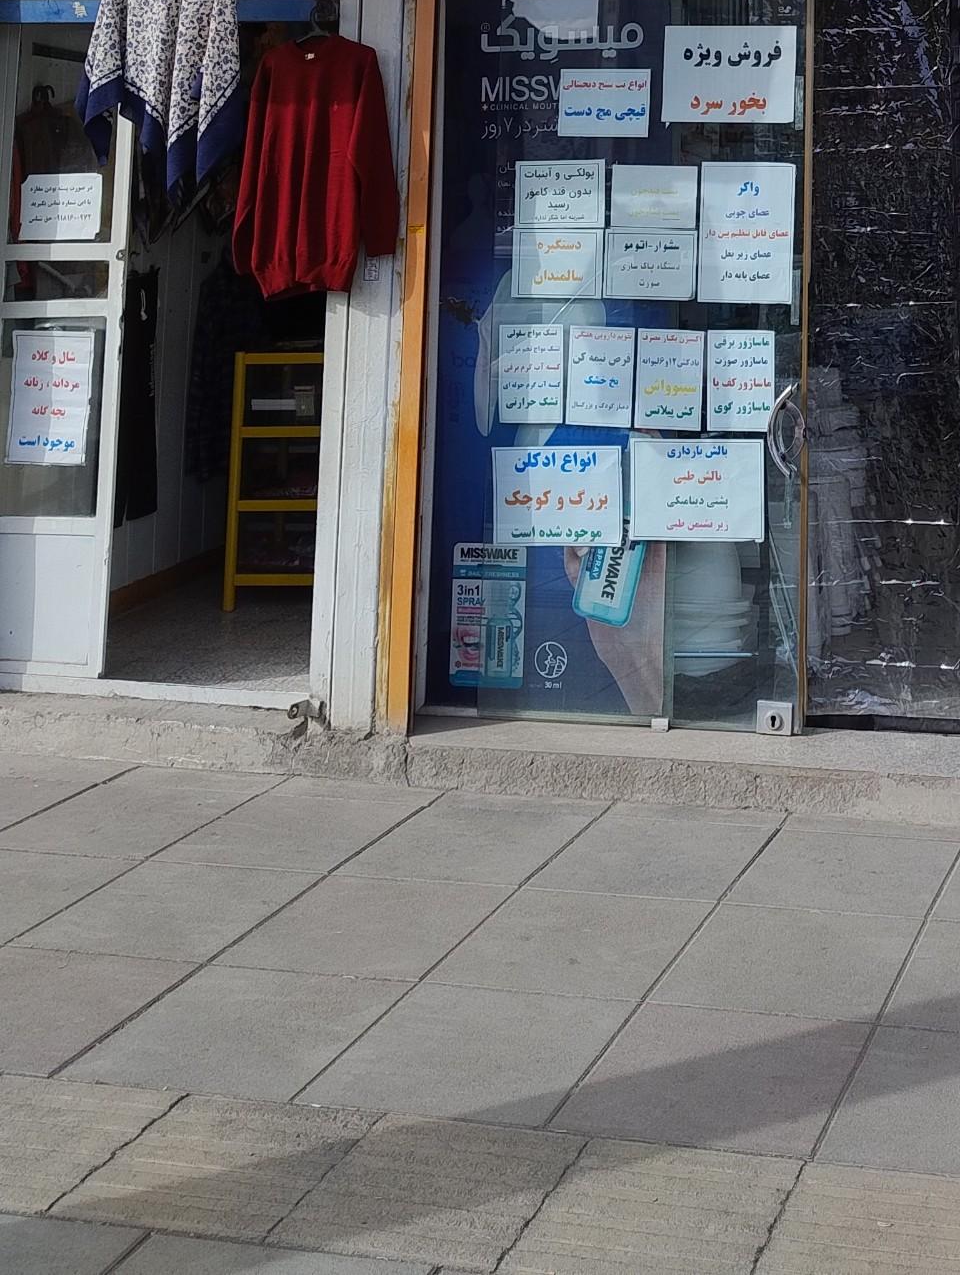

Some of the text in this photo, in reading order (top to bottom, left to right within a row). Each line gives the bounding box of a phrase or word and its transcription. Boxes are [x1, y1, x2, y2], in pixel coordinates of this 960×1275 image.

[684, 41, 782, 67] فروش ویژه
[481, 75, 561, 102] MISS
[690, 92, 767, 115] بخور سرد
[564, 103, 646, 121] قیچی مچ دست
[524, 167, 553, 179] آبنبات
[555, 171, 560, 180] و
[737, 181, 760, 196] واکر
[547, 202, 570, 211] رسید
[748, 208, 770, 218] عصای
[537, 237, 582, 254] دستگیره
[533, 269, 584, 285] سالمندان
[639, 278, 660, 289] صورت
[714, 336, 735, 349] برقی
[32, 350, 75, 364] شال و کلاه
[572, 352, 631, 366] قرص نیمه کن
[714, 357, 738, 367] صورت
[506, 397, 558, 409] تشک حرارتی
[32, 405, 66, 419] بچه گانه
[645, 405, 694, 418] کش پیلاتس
[19, 435, 75, 452] موجود است
[667, 445, 728, 458] بالش بارداری
[514, 451, 597, 473] انواع ادکلن
[673, 470, 721, 484] بالش طبی
[505, 489, 608, 511] بزرگ و کوچک
[511, 525, 602, 542] موجود شده است
[460, 548, 519, 560] MISSWAKE
[457, 584, 480, 596] 3in1
[457, 597, 485, 605] SPRAY
